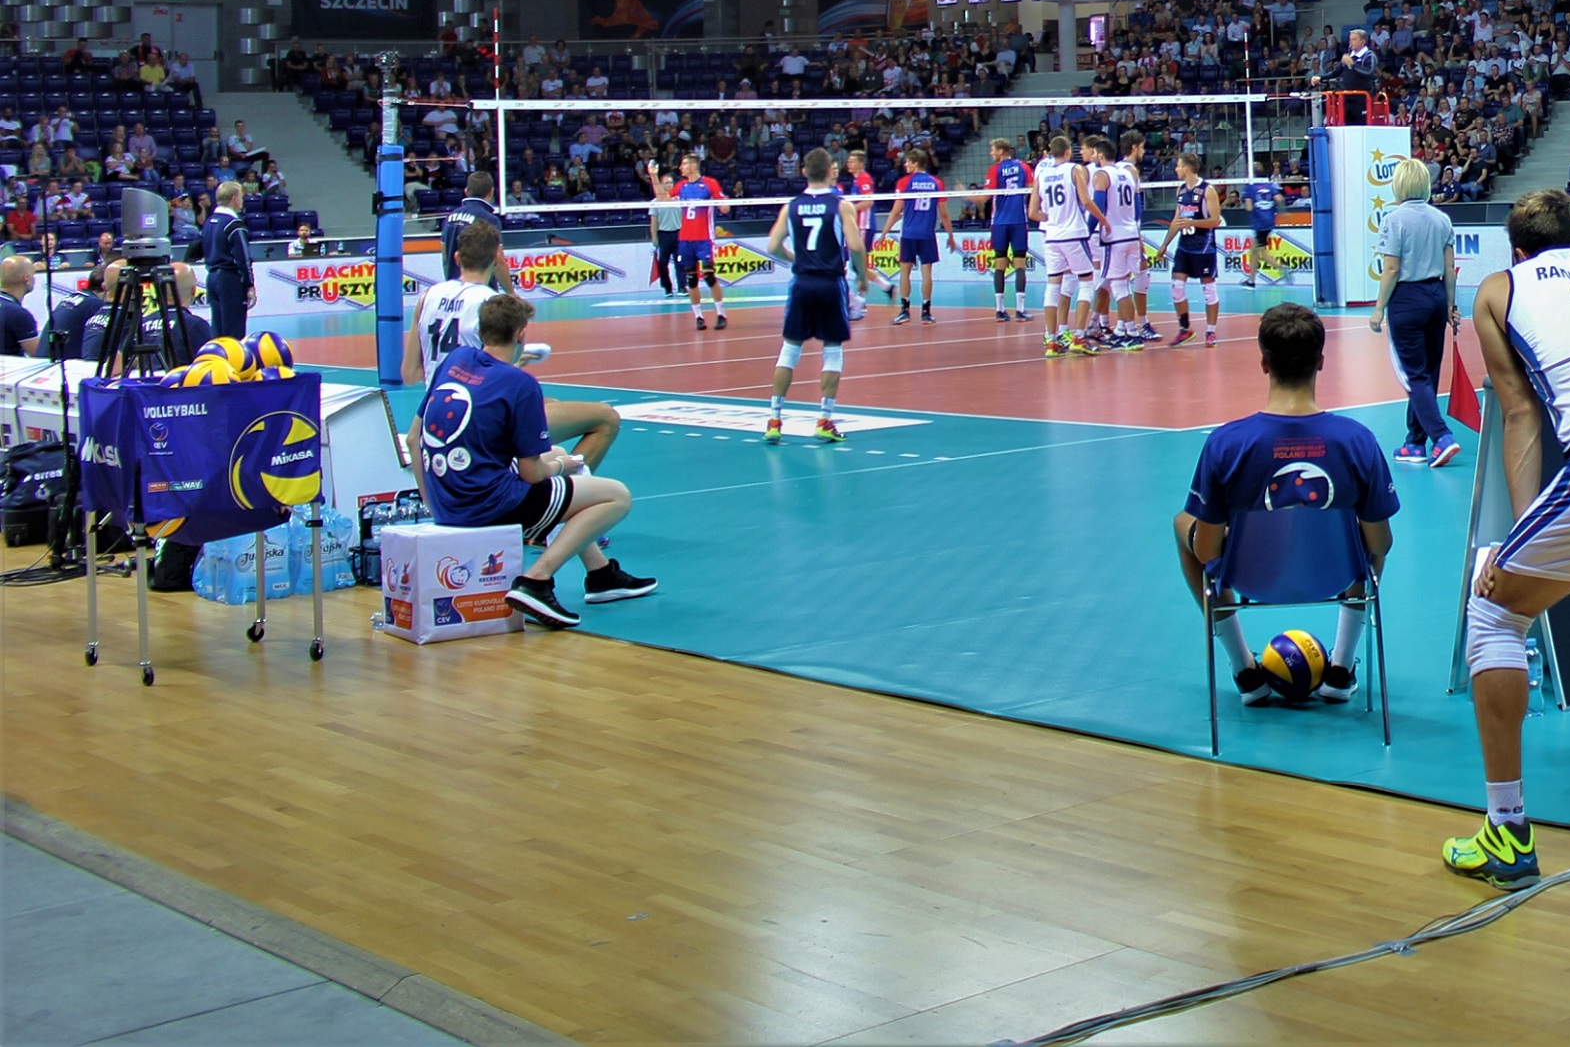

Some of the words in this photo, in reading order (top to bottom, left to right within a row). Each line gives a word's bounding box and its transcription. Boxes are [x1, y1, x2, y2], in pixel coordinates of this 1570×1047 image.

[1376, 162, 1400, 180] LOTT
[1045, 184, 1066, 208] 16
[1117, 184, 1133, 206] 10
[448, 213, 475, 224] ITALIA
[686, 204, 697, 220] 6
[802, 218, 823, 251] 7
[510, 267, 606, 290] RUSZYŃSKI
[428, 318, 460, 361] 14
[143, 403, 208, 419] VOLLEYBALL
[1273, 451, 1305, 459] POLAND
[457, 600, 474, 609] LOTTO
[473, 605, 496, 613] POLAND
[436, 616, 451, 624] CEV
